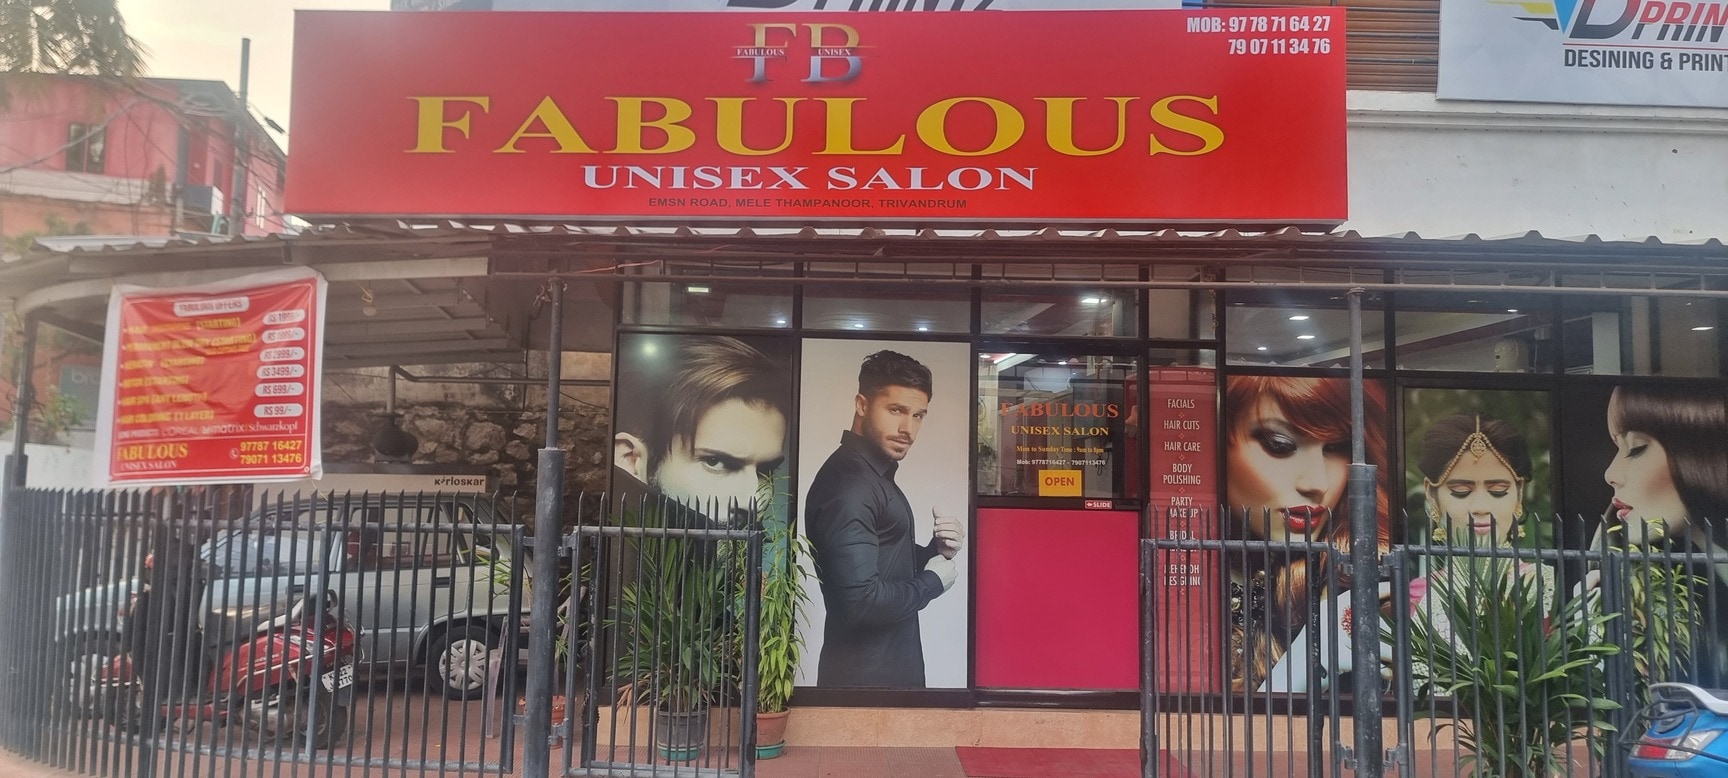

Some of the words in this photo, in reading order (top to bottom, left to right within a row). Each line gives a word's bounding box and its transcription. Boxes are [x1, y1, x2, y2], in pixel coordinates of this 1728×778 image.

[1186, 17, 1226, 32] MOB:
[1228, 16, 1247, 32] 97
[1250, 16, 1268, 32] 78
[1271, 16, 1286, 32] 71
[1289, 16, 1310, 32] 64
[1312, 15, 1331, 32] 27
[1228, 39, 1247, 54] 79
[1250, 39, 1268, 54] 07
[1271, 39, 1286, 54] 11
[1289, 38, 1310, 54] 34
[1312, 38, 1331, 54] 76
[737, 48, 785, 56] FABULOUS
[818, 48, 851, 56] UNISEX
[1564, 49, 1654, 69] DESINING
[1660, 52, 1673, 70] &
[402, 94, 1226, 157] FABULOUS
[580, 165, 810, 190] UNISEX
[827, 166, 1039, 191] SALON
[648, 198, 686, 207] EMSN
[690, 198, 731, 208] ROAD,
[736, 199, 771, 207] MELE
[776, 199, 874, 209] THAMPANOOR,
[878, 199, 967, 208] TRIVANDRUM
[263, 385, 271, 395] RS
[1167, 399, 1195, 409] FACIALS
[264, 405, 273, 415] RS
[274, 405, 292, 415] 99/-
[1000, 402, 1119, 418] FABULOUS
[1010, 425, 1060, 435] UNISEX
[1063, 426, 1110, 436] SALON
[1163, 420, 1181, 430] HAIR
[1183, 420, 1200, 430] CUTS
[240, 440, 270, 451] 97787
[272, 439, 302, 451] 16427
[1164, 441, 1181, 451] HAIR
[1183, 442, 1201, 452] CARE
[240, 454, 268, 465] 79071
[272, 453, 302, 464] 13476
[1172, 463, 1193, 473] BODY
[1044, 476, 1075, 487] OPEN
[1163, 475, 1201, 485] POLISHING
[1171, 496, 1193, 506] PARTY
